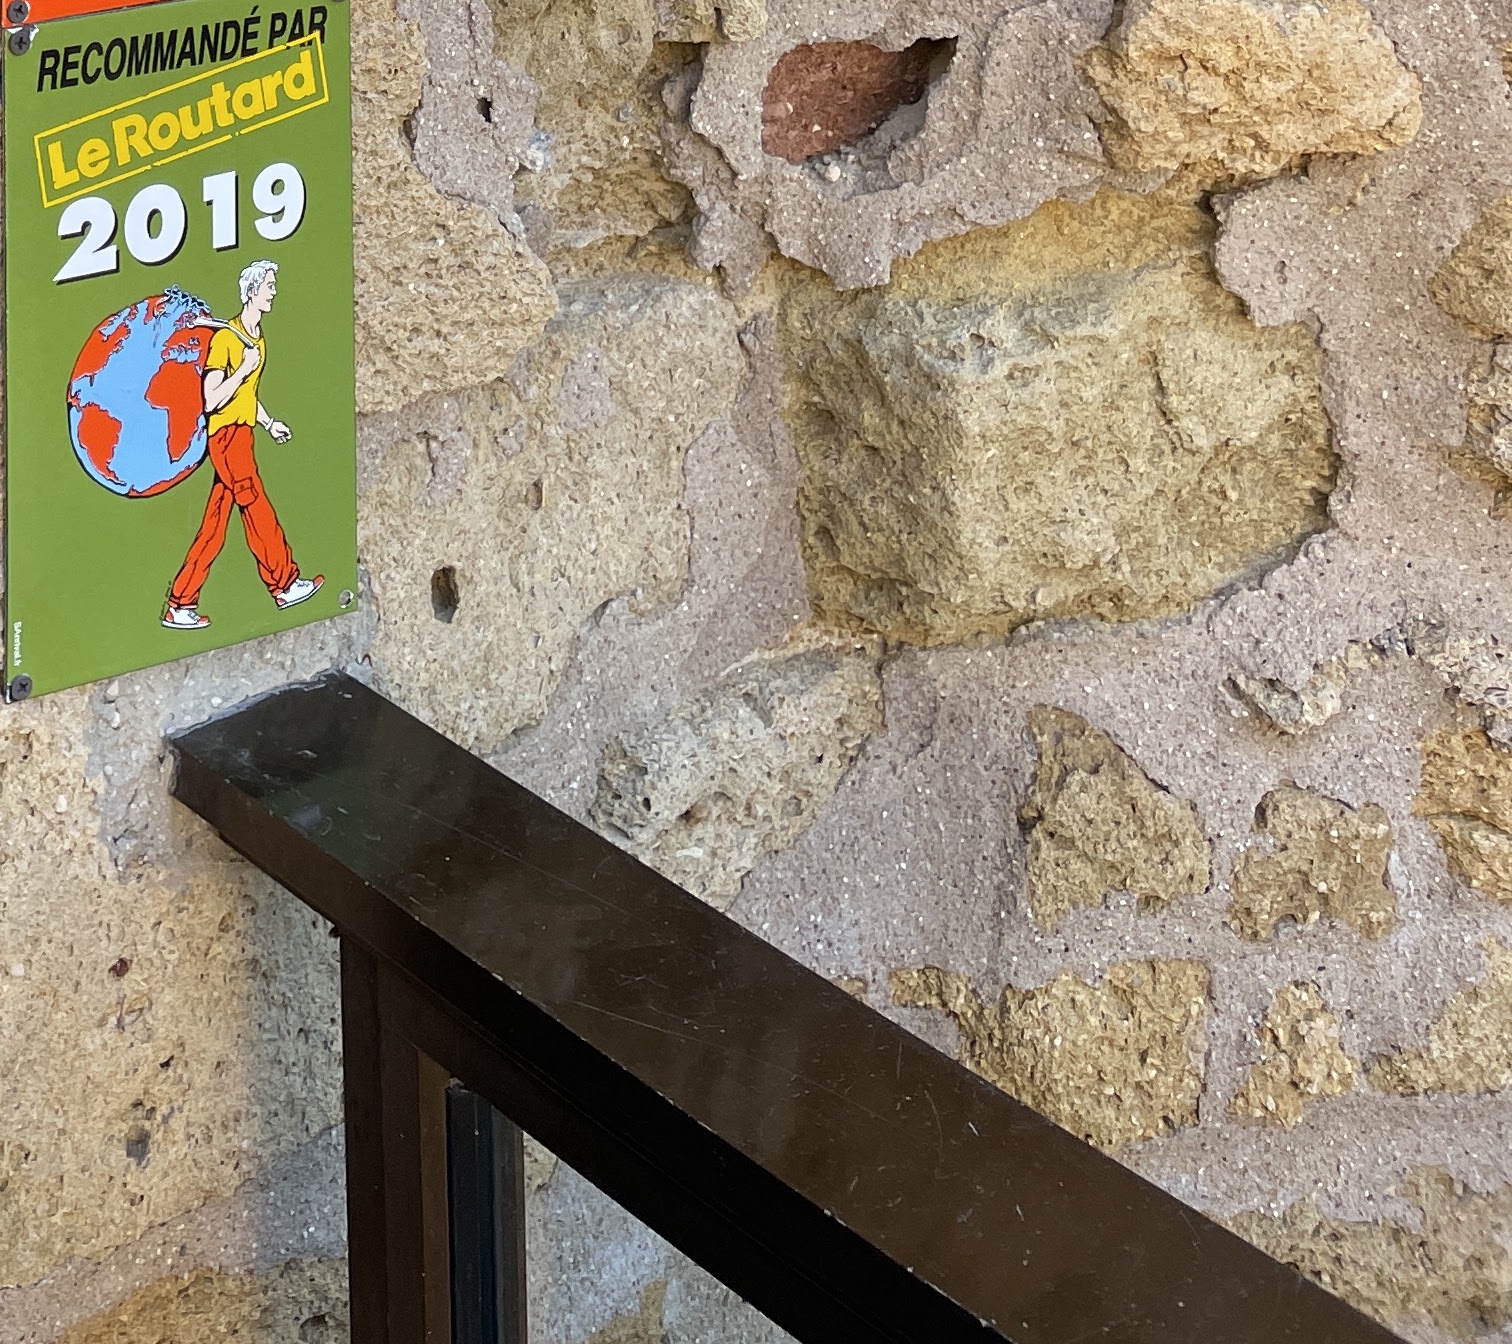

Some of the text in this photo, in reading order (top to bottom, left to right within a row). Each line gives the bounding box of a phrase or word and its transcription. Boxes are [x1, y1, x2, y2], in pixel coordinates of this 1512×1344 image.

[37, 5, 328, 93] RECOMMANDÉ PAR
[53, 162, 307, 286] 2019
